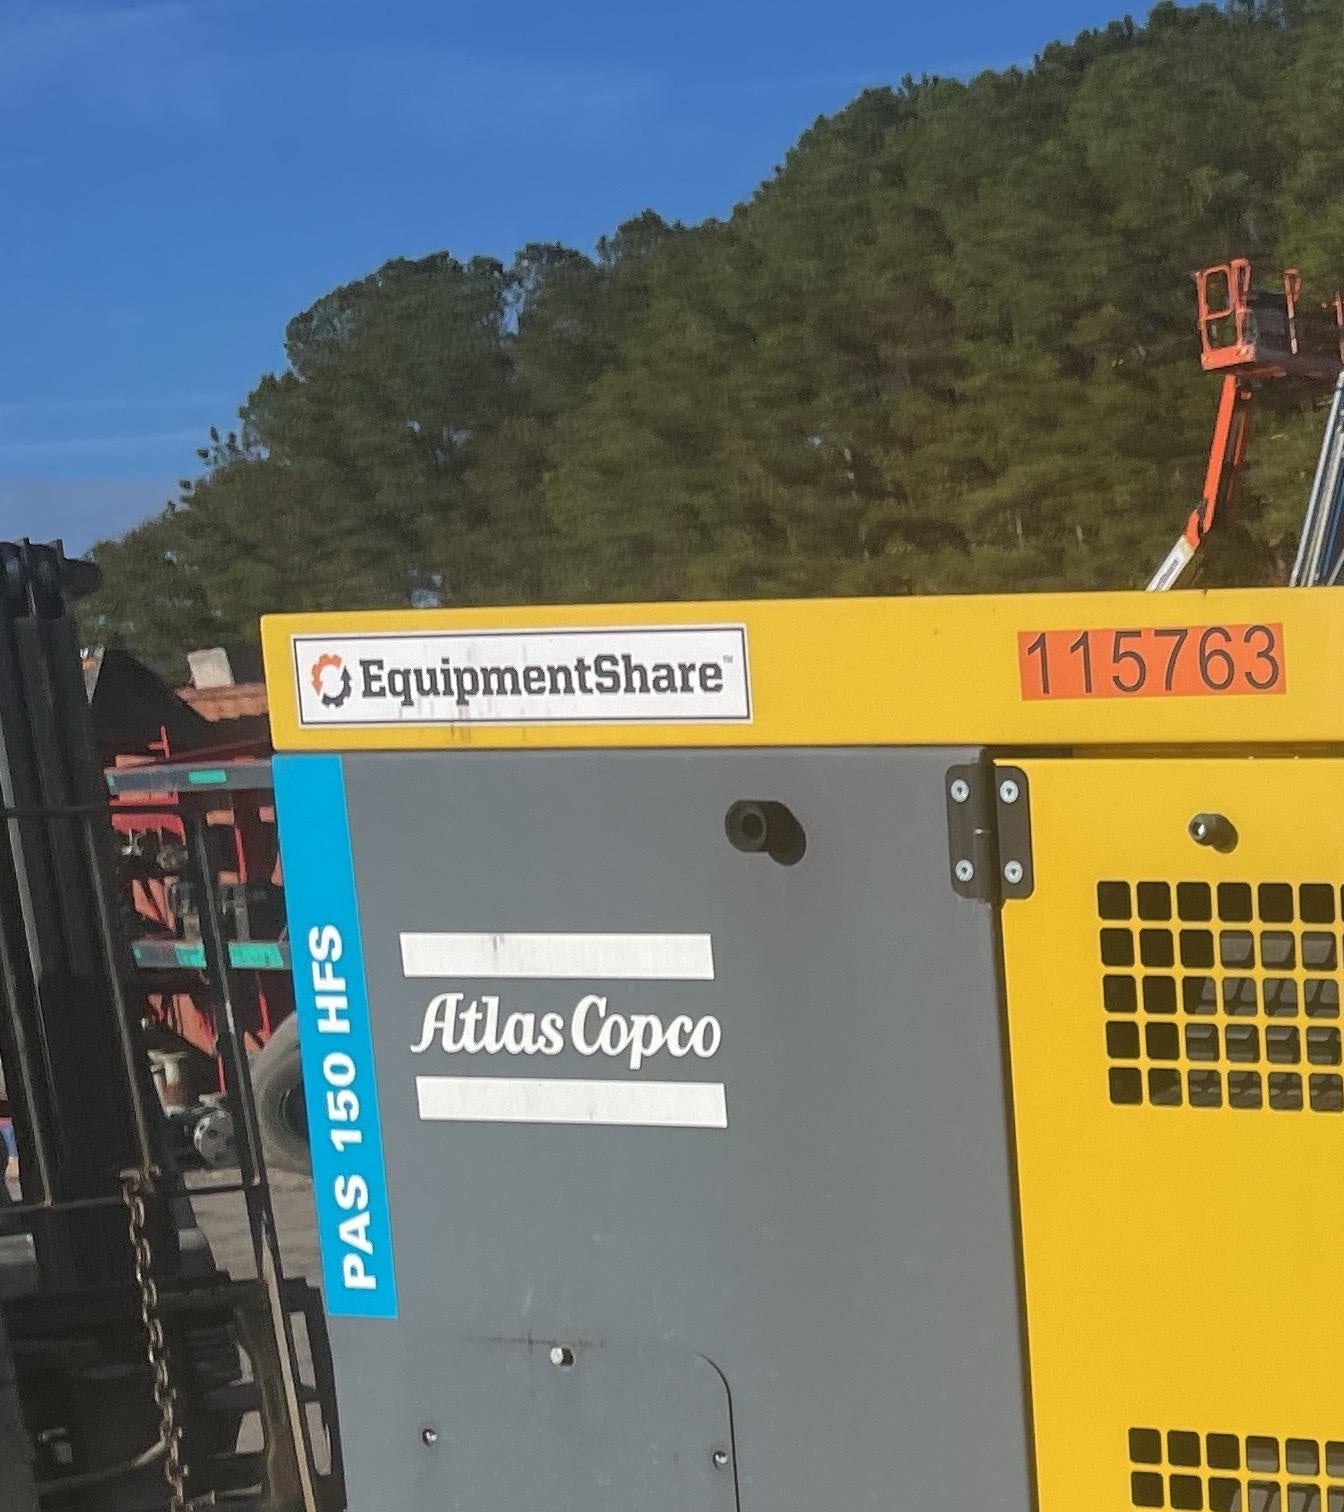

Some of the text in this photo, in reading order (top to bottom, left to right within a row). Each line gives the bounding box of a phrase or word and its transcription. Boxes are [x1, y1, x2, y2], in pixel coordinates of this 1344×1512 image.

[1027, 625, 1279, 694] 115763
[411, 991, 721, 1070] Atlas Copco
[308, 924, 376, 1291] PAS 150 HFS
